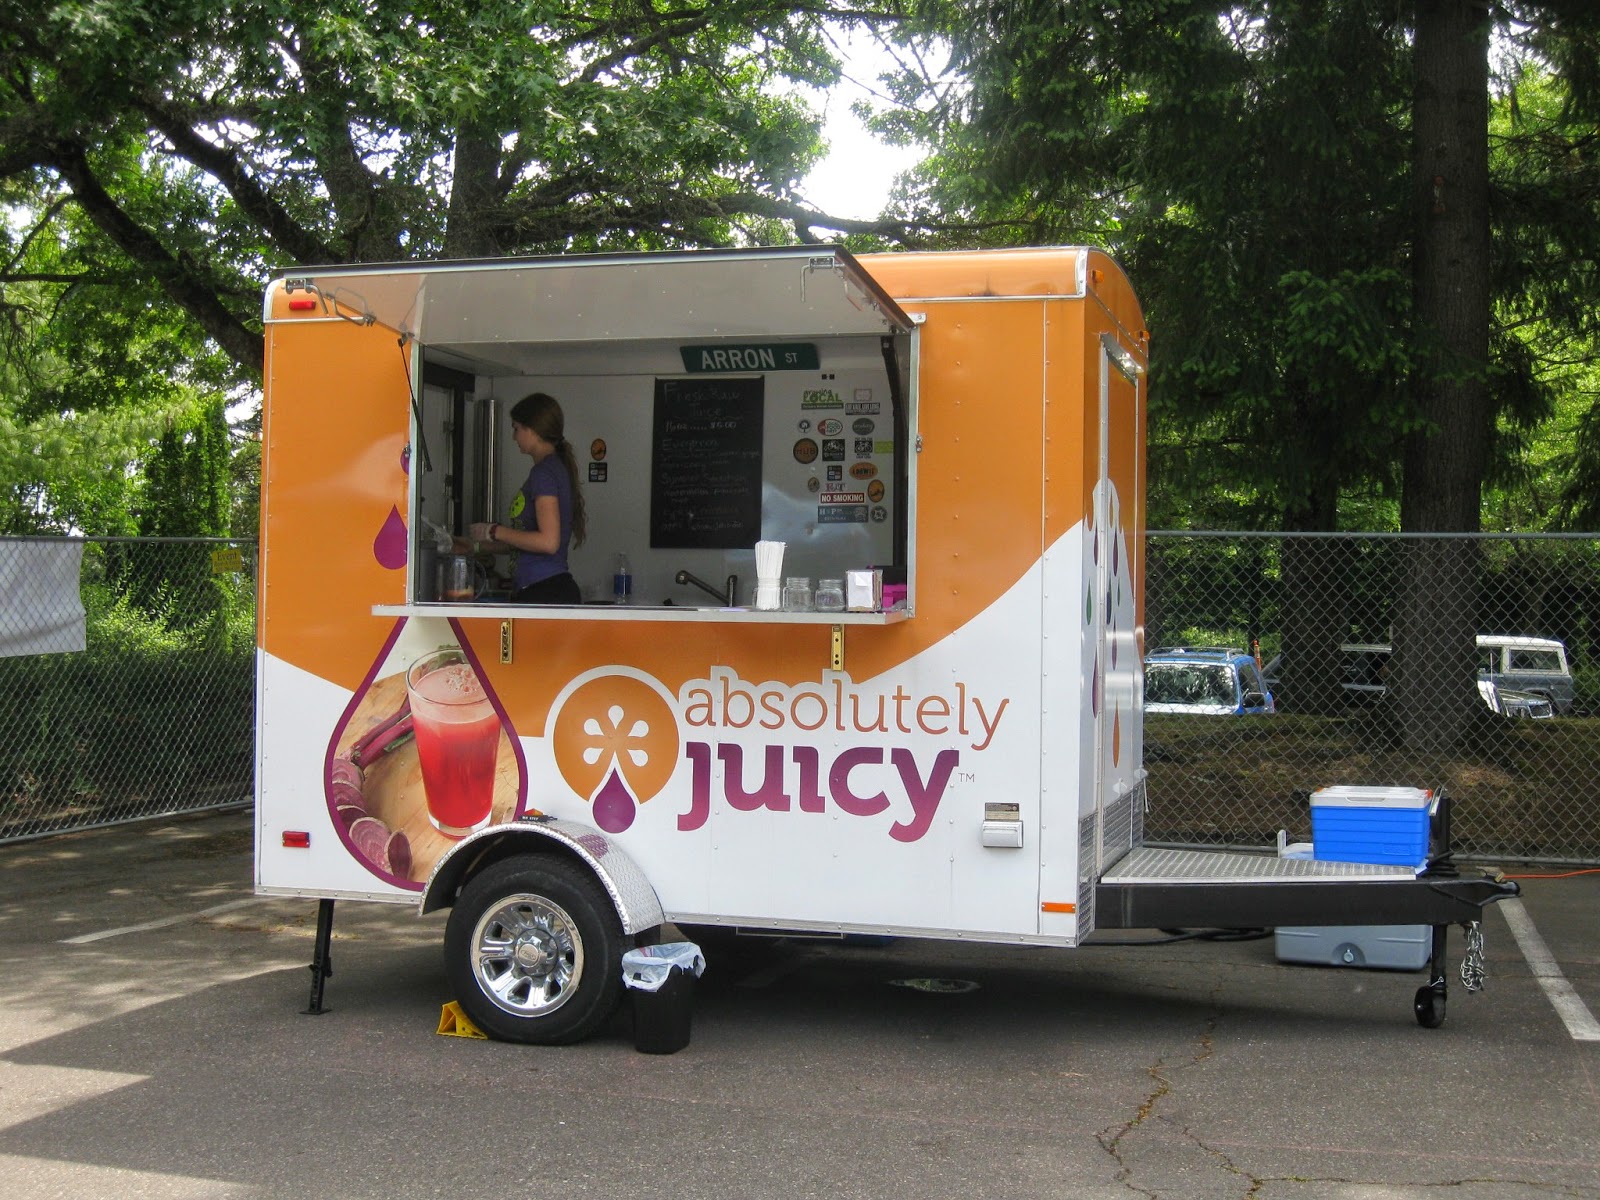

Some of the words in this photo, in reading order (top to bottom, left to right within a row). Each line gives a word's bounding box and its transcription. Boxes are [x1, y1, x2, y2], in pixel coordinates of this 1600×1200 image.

[702, 349, 775, 370] ARRON
[785, 352, 797, 364] ST
[803, 393, 842, 402] LOCAL
[833, 494, 864, 502] SMOKING
[684, 676, 1010, 751] absolutely
[958, 772, 975, 783] TM
[677, 741, 960, 843] juicy
